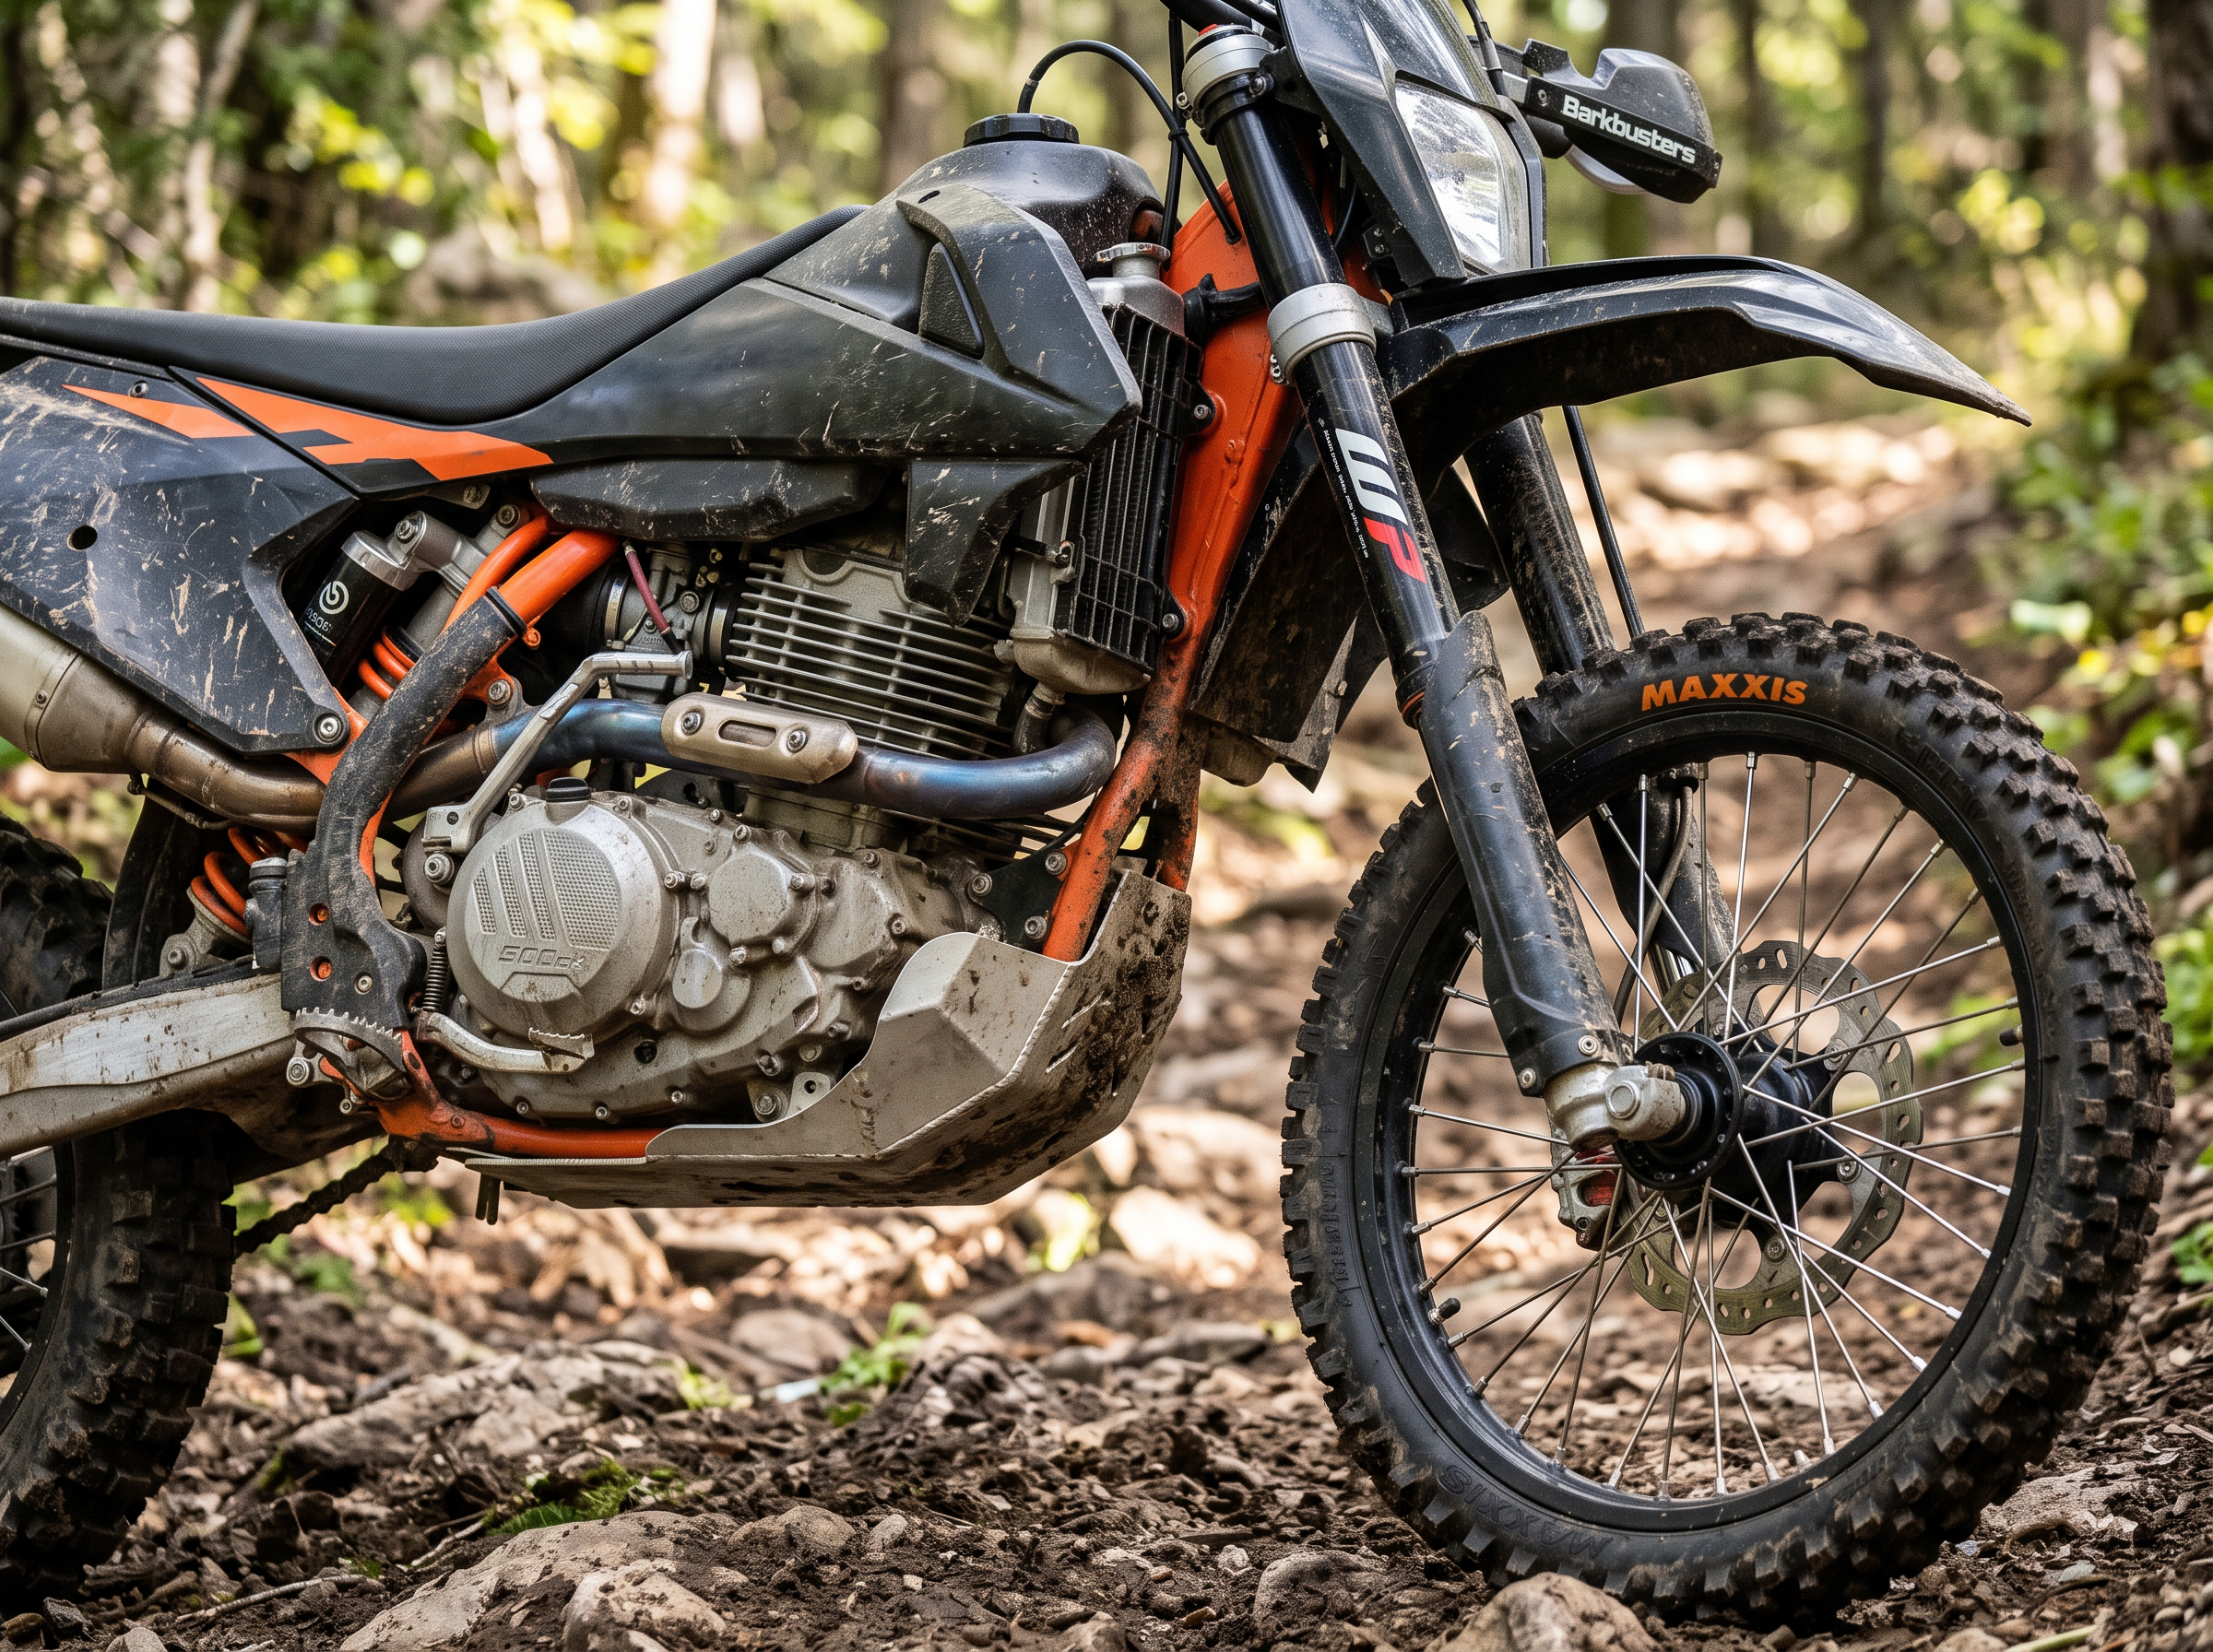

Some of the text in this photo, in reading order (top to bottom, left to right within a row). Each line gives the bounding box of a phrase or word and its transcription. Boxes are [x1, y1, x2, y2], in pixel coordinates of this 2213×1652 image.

[1563, 95, 1696, 164] Barkbusters
[1335, 428, 1427, 584] WP
[1641, 673, 1808, 712] MAXXIS
[1438, 1464, 1614, 1559] MAXXIS
